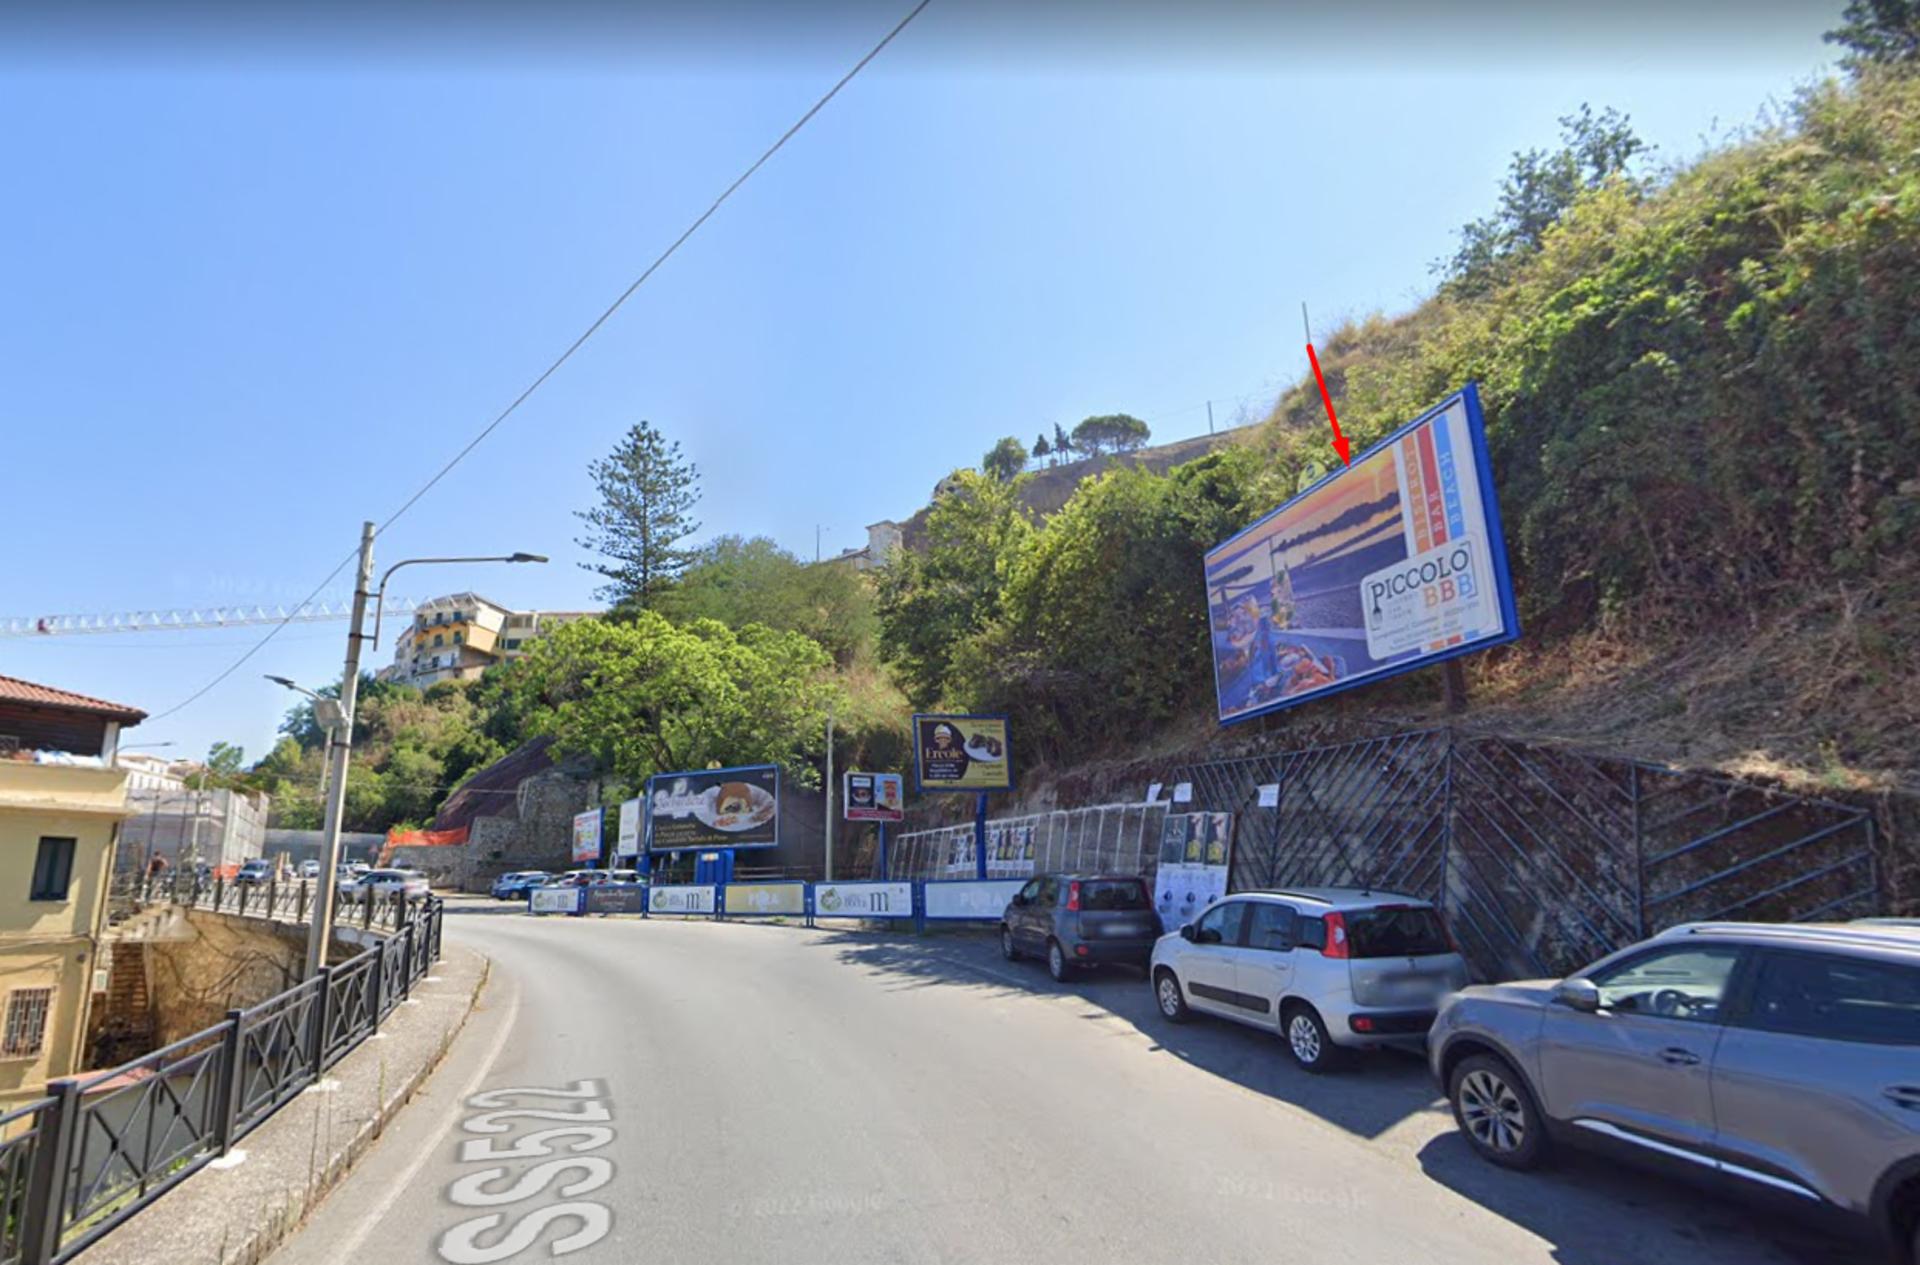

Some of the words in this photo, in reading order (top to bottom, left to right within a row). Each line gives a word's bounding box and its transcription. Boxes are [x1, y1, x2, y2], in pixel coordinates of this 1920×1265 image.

[1428, 491, 1445, 533] BAR
[1439, 451, 1462, 525] BEACH
[1371, 549, 1470, 612] PICCOLO
[1423, 573, 1474, 610] BBB
